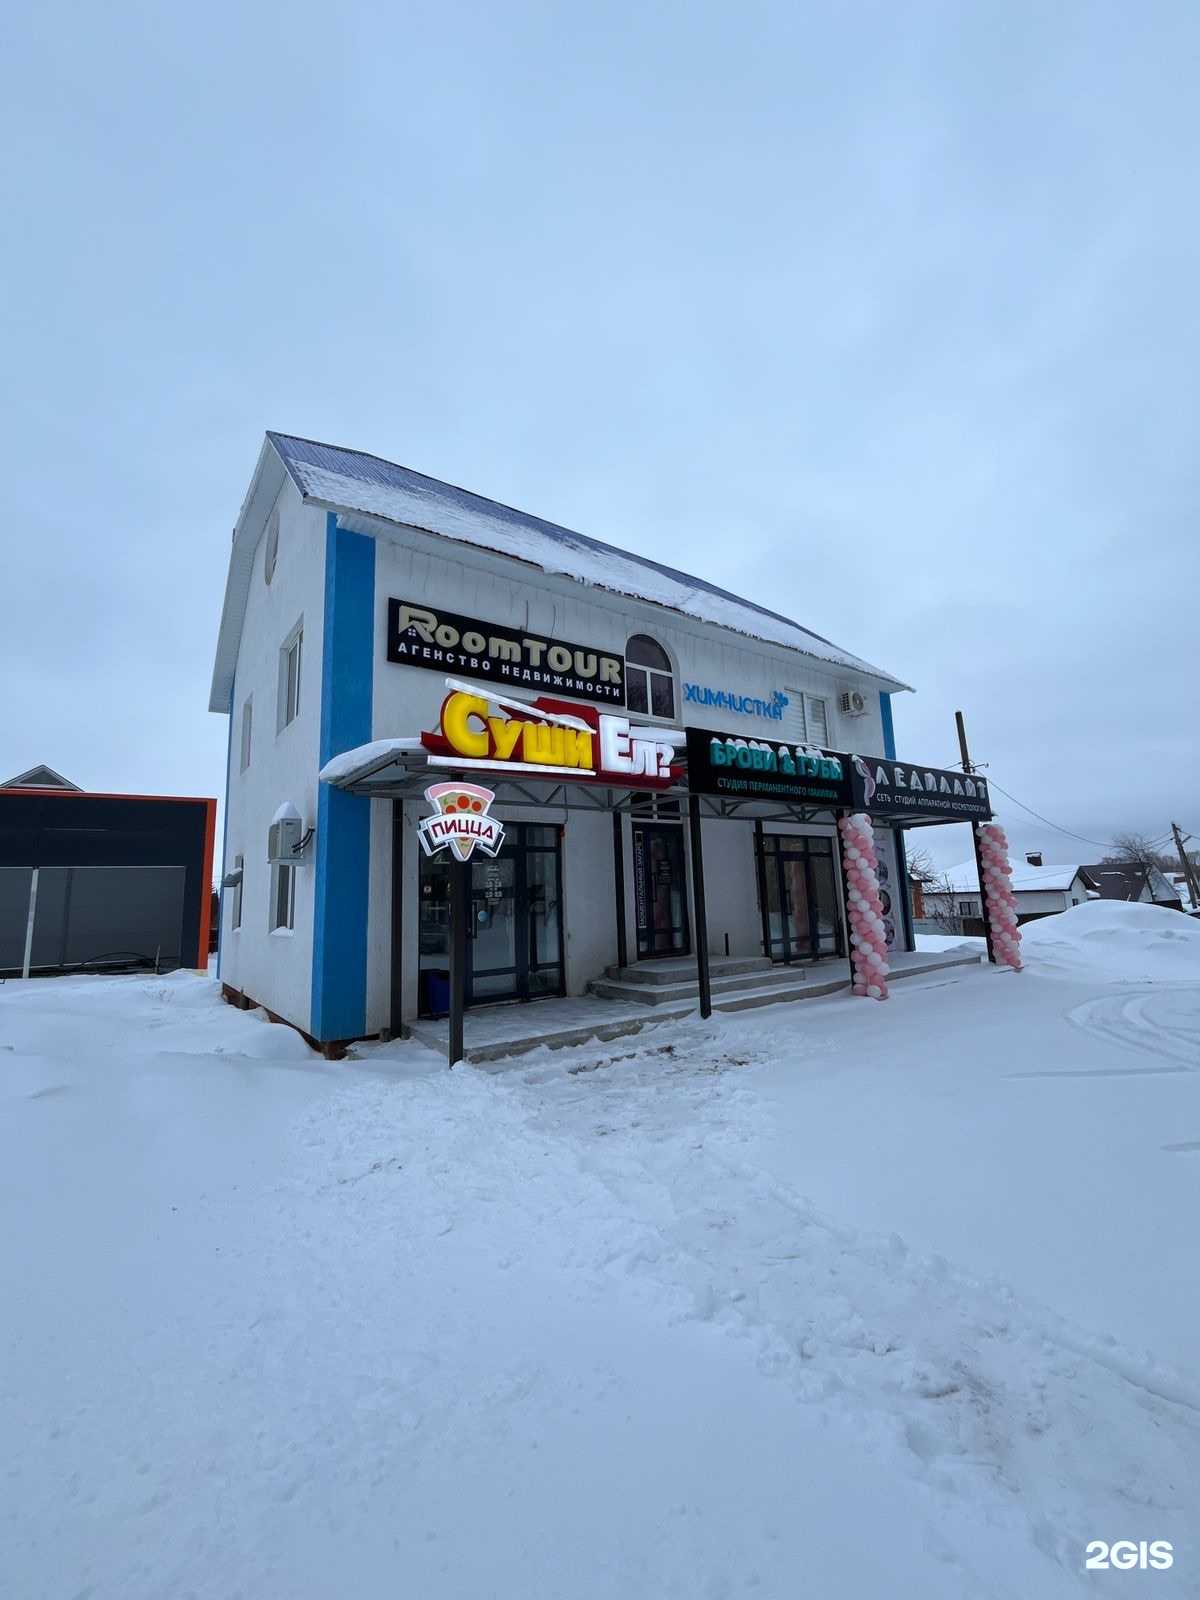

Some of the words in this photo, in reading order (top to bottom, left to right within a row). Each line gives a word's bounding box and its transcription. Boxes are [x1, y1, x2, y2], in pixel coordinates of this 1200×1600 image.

[398, 642, 491, 671] АГЕНСТВО
[501, 664, 620, 697] НЕДВИЖИМОСТИ
[709, 739, 777, 772] БРОВИ
[779, 748, 795, 776] &
[796, 750, 843, 780] ГУБЫ
[717, 777, 747, 791] СТУДИЯ
[749, 780, 806, 796] ПЕРМАНЕНТНОГО
[876, 792, 891, 803] СЕТЬ
[431, 819, 493, 840] ПИЦЦА
